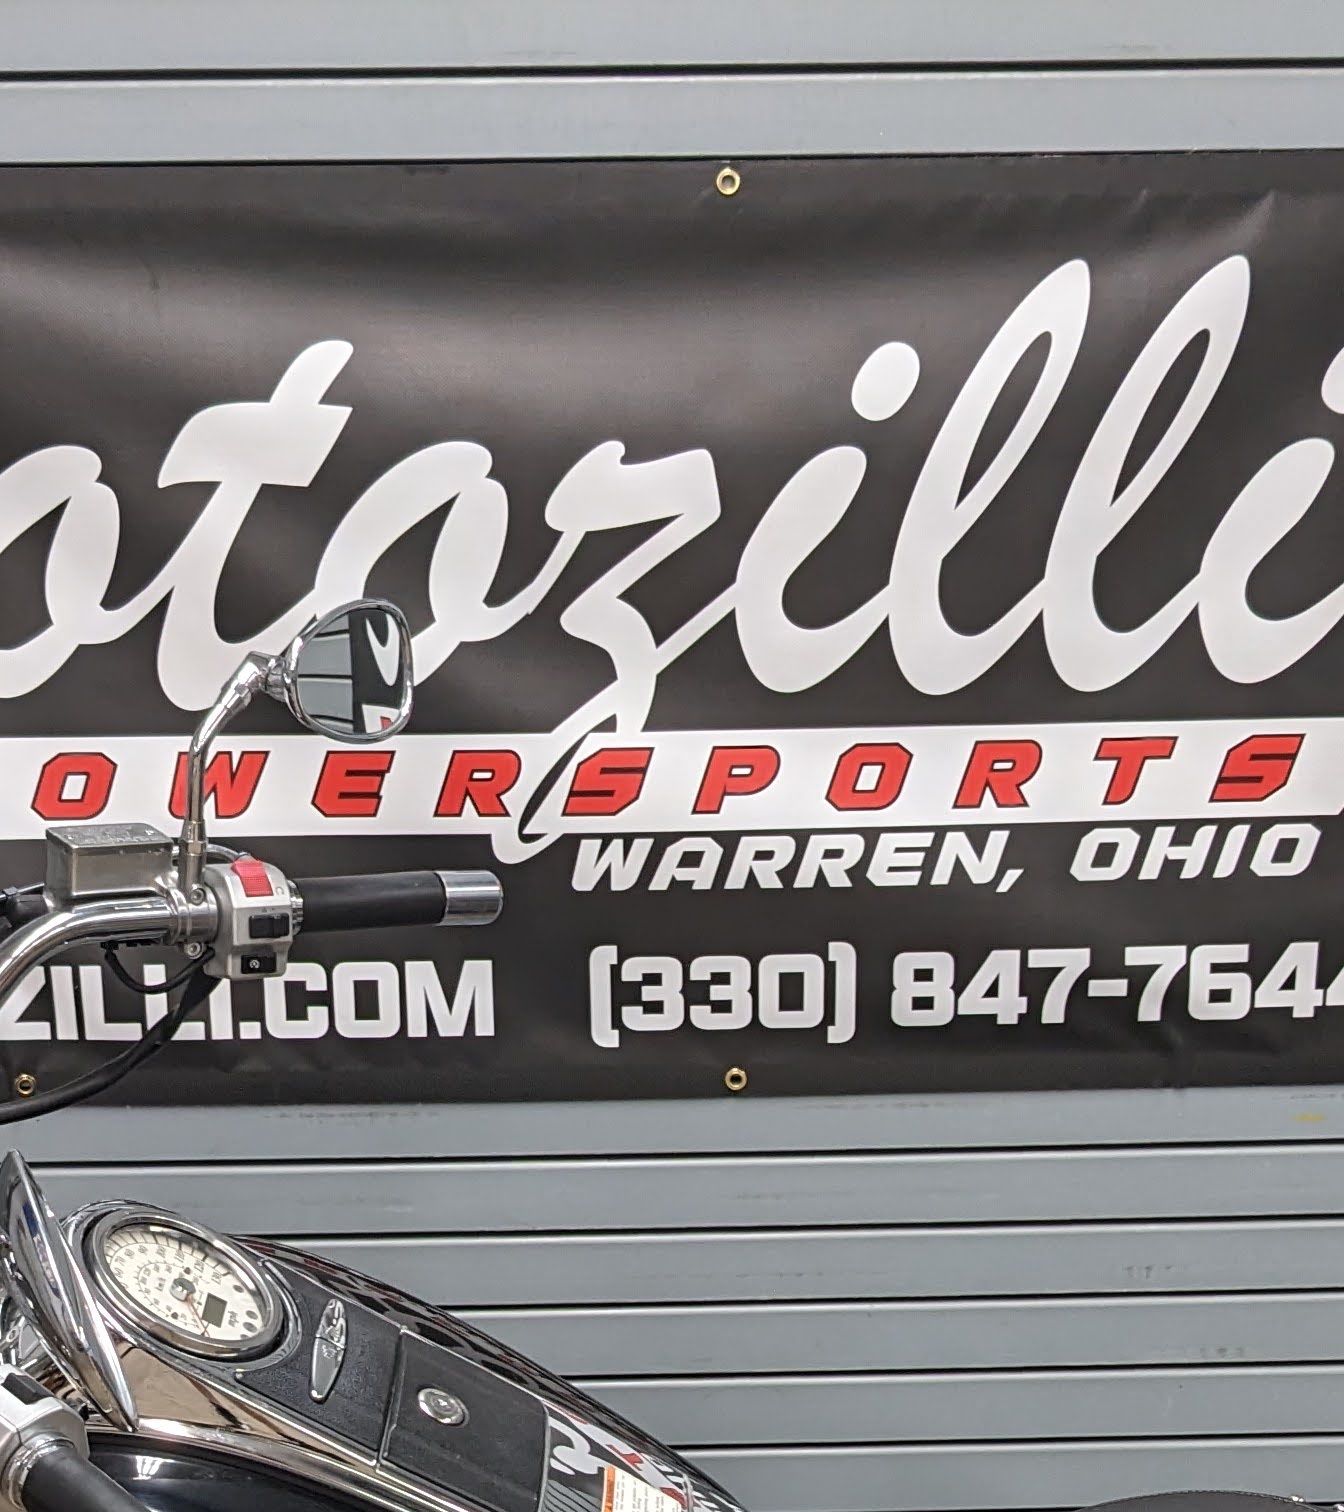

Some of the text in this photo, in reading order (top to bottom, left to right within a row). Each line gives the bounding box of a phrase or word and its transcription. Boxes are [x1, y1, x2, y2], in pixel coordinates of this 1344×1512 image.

[570, 823, 1322, 894] WARREN, OHIO
[589, 942, 857, 1048] (330)
